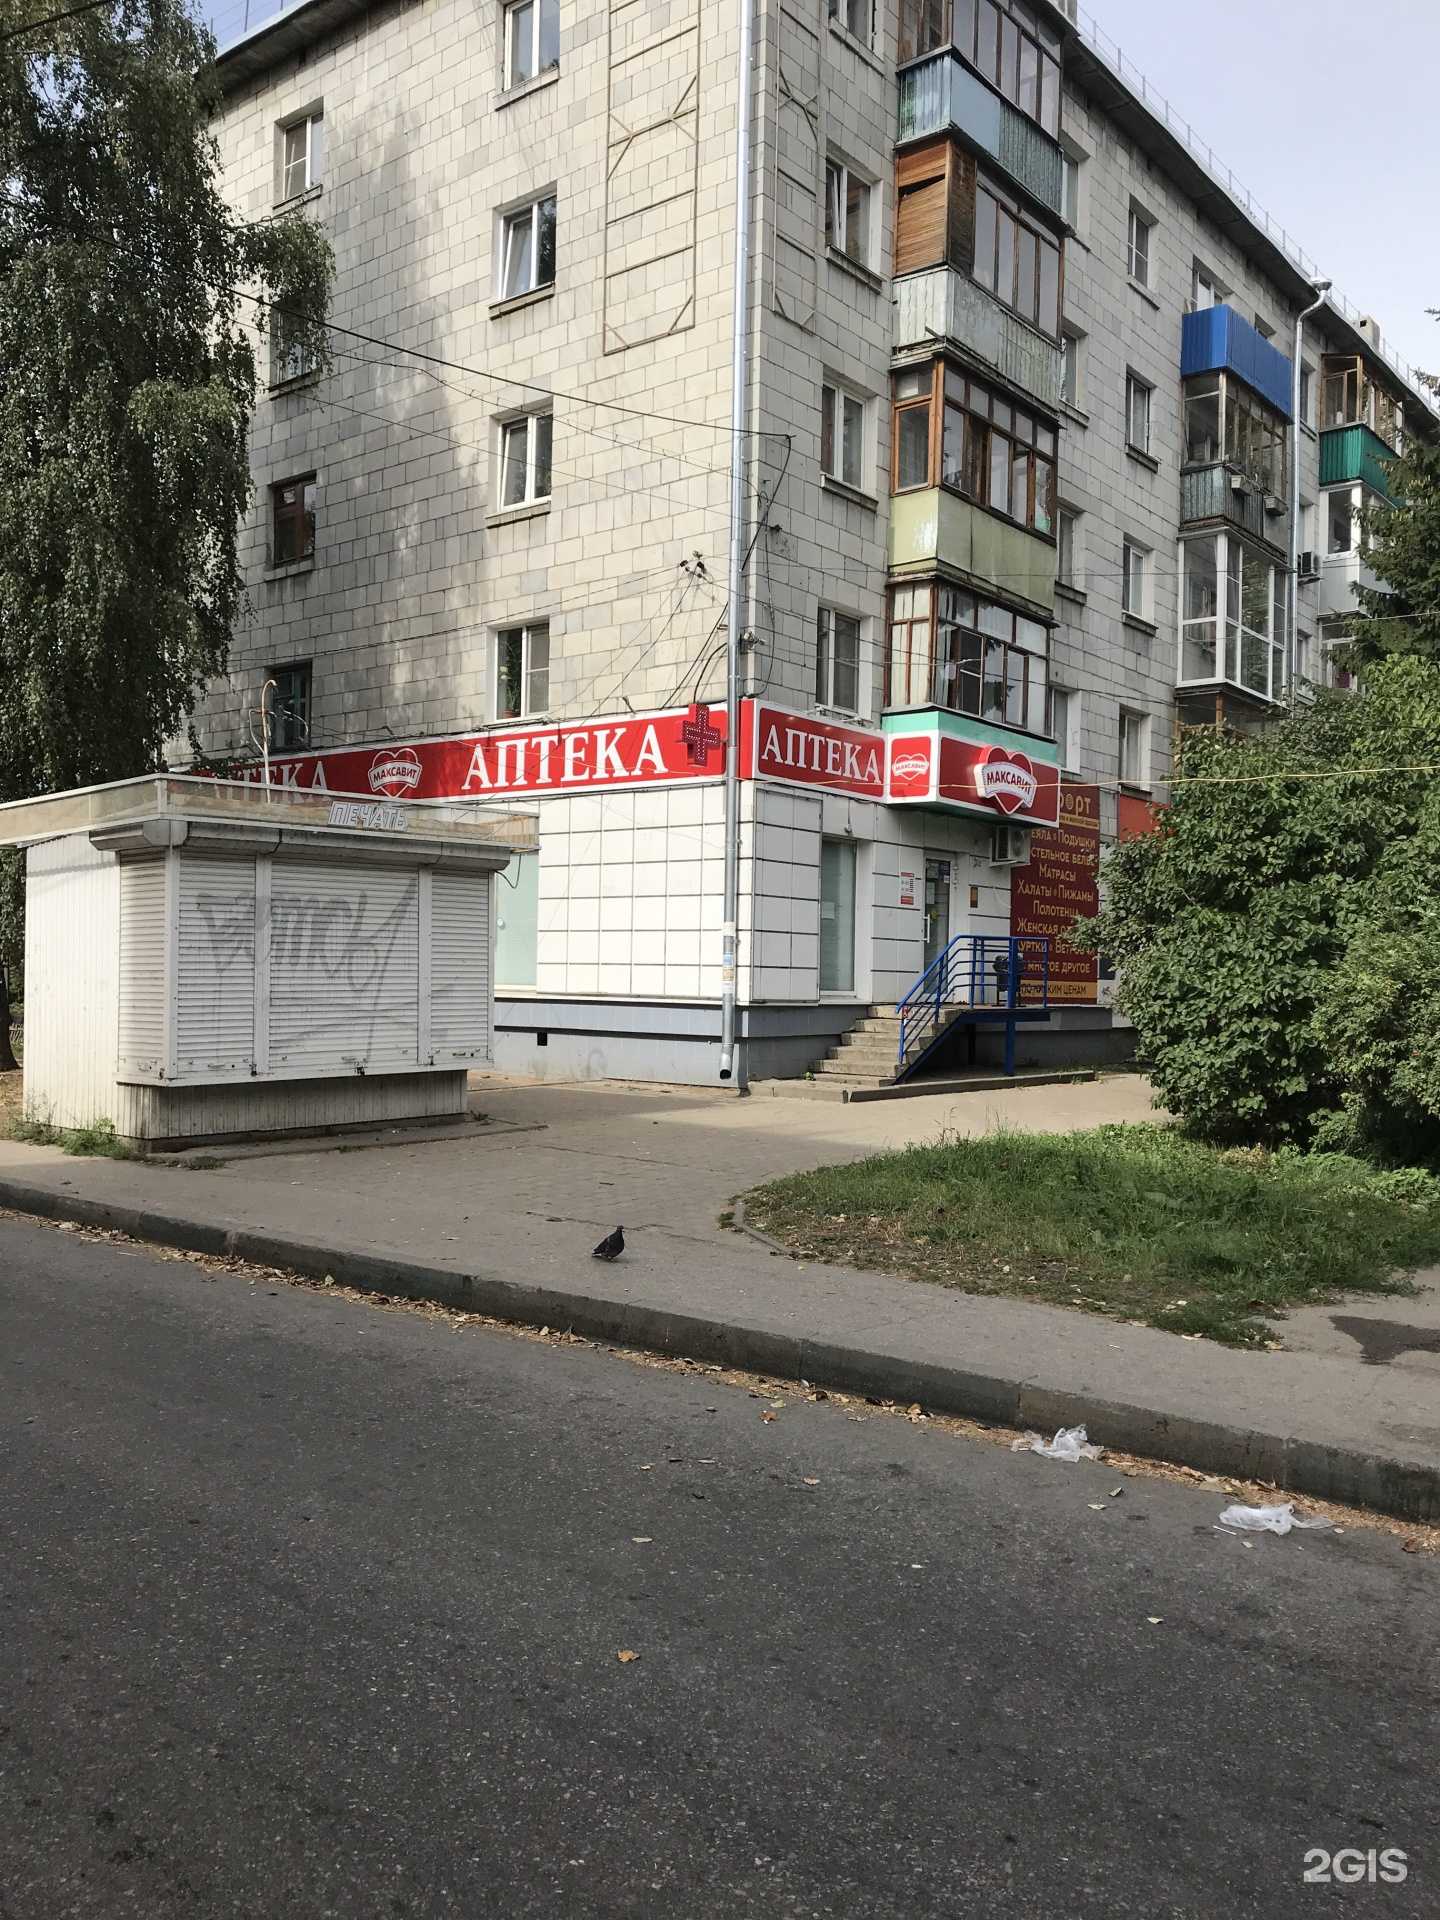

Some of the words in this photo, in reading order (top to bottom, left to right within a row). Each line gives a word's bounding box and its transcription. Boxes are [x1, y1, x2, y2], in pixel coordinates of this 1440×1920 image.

[461, 724, 669, 790] АПТЕКА
[761, 724, 882, 784] АПТЕКА
[373, 766, 417, 782] МАКСАВИТ
[986, 771, 1033, 796] МАКСАВИТ
[328, 801, 409, 832] ПЕЧАТЬ
[1031, 829, 1052, 841] ЕЯЛА
[1031, 847, 1070, 863] СТЕЛЬНОЕ
[1028, 961, 1060, 972] МНООЕ
[1061, 963, 1091, 975] ДРУГОЕ
